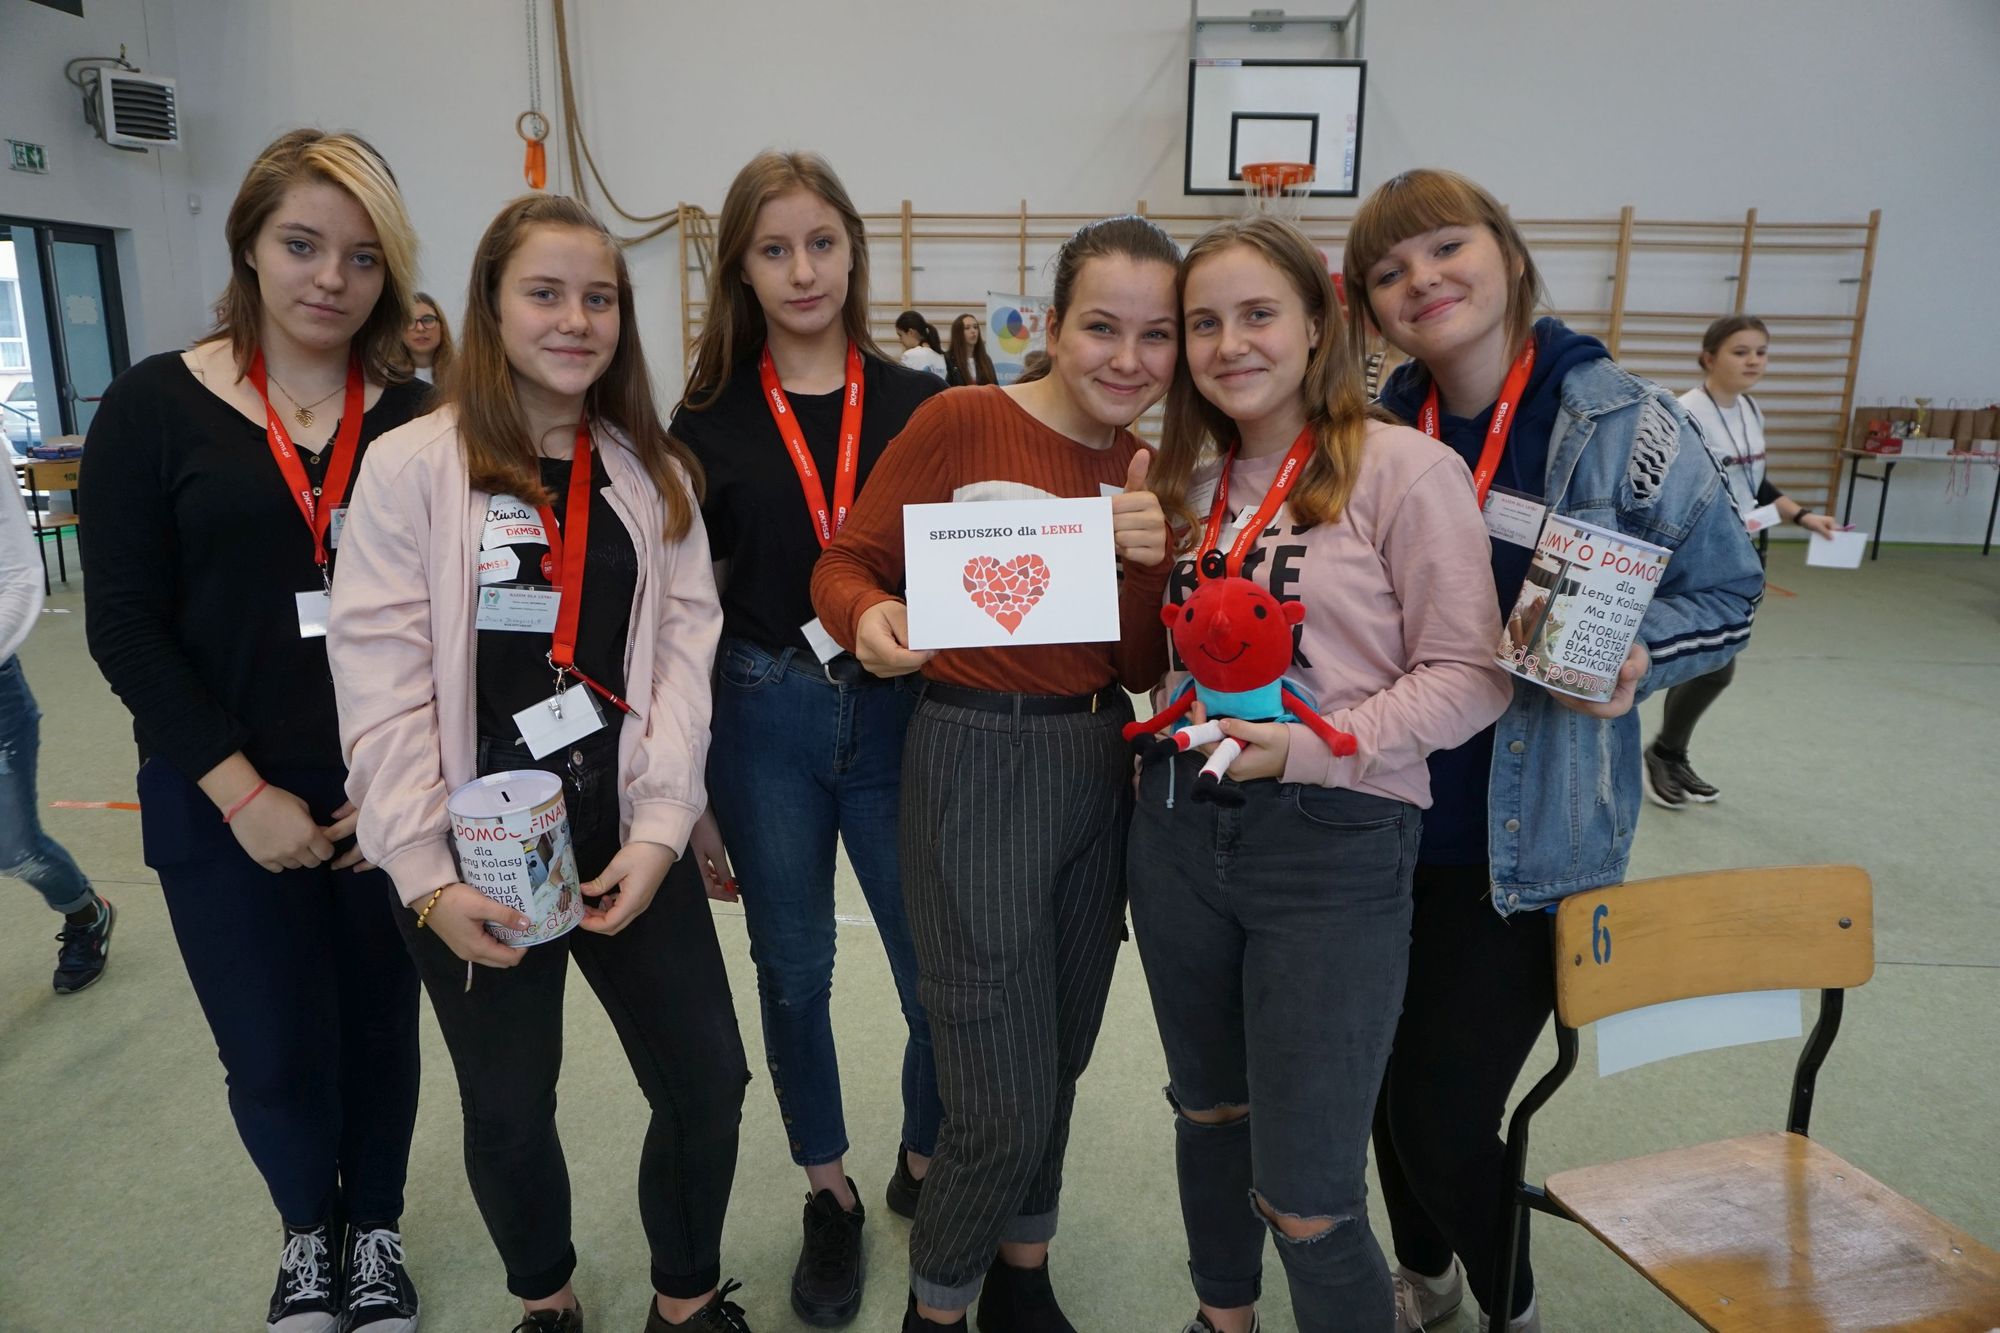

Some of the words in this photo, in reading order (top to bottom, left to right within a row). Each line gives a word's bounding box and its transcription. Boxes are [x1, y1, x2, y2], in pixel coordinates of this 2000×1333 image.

[929, 527, 1013, 540] SERDUSZKO
[1017, 527, 1037, 536] dla
[1041, 524, 1083, 535] LENKI
[1540, 531, 1574, 554] IMY
[1578, 544, 1594, 561] O
[1581, 585, 1613, 605] Leny
[1616, 580, 1636, 595] dla
[1584, 605, 1605, 619] Ma
[1610, 612, 1622, 624] 10
[1624, 615, 1637, 627] lat
[1572, 630, 1590, 644] NA
[1578, 620, 1630, 642] CHORUJE
[474, 846, 492, 856] dla
[481, 858, 522, 869] Kolasy
[468, 870, 480, 881] Ma
[483, 873, 495, 882] 10
[498, 872, 518, 881] lat
[471, 884, 518, 895] HORUJE
[1593, 904, 1611, 964] 6
